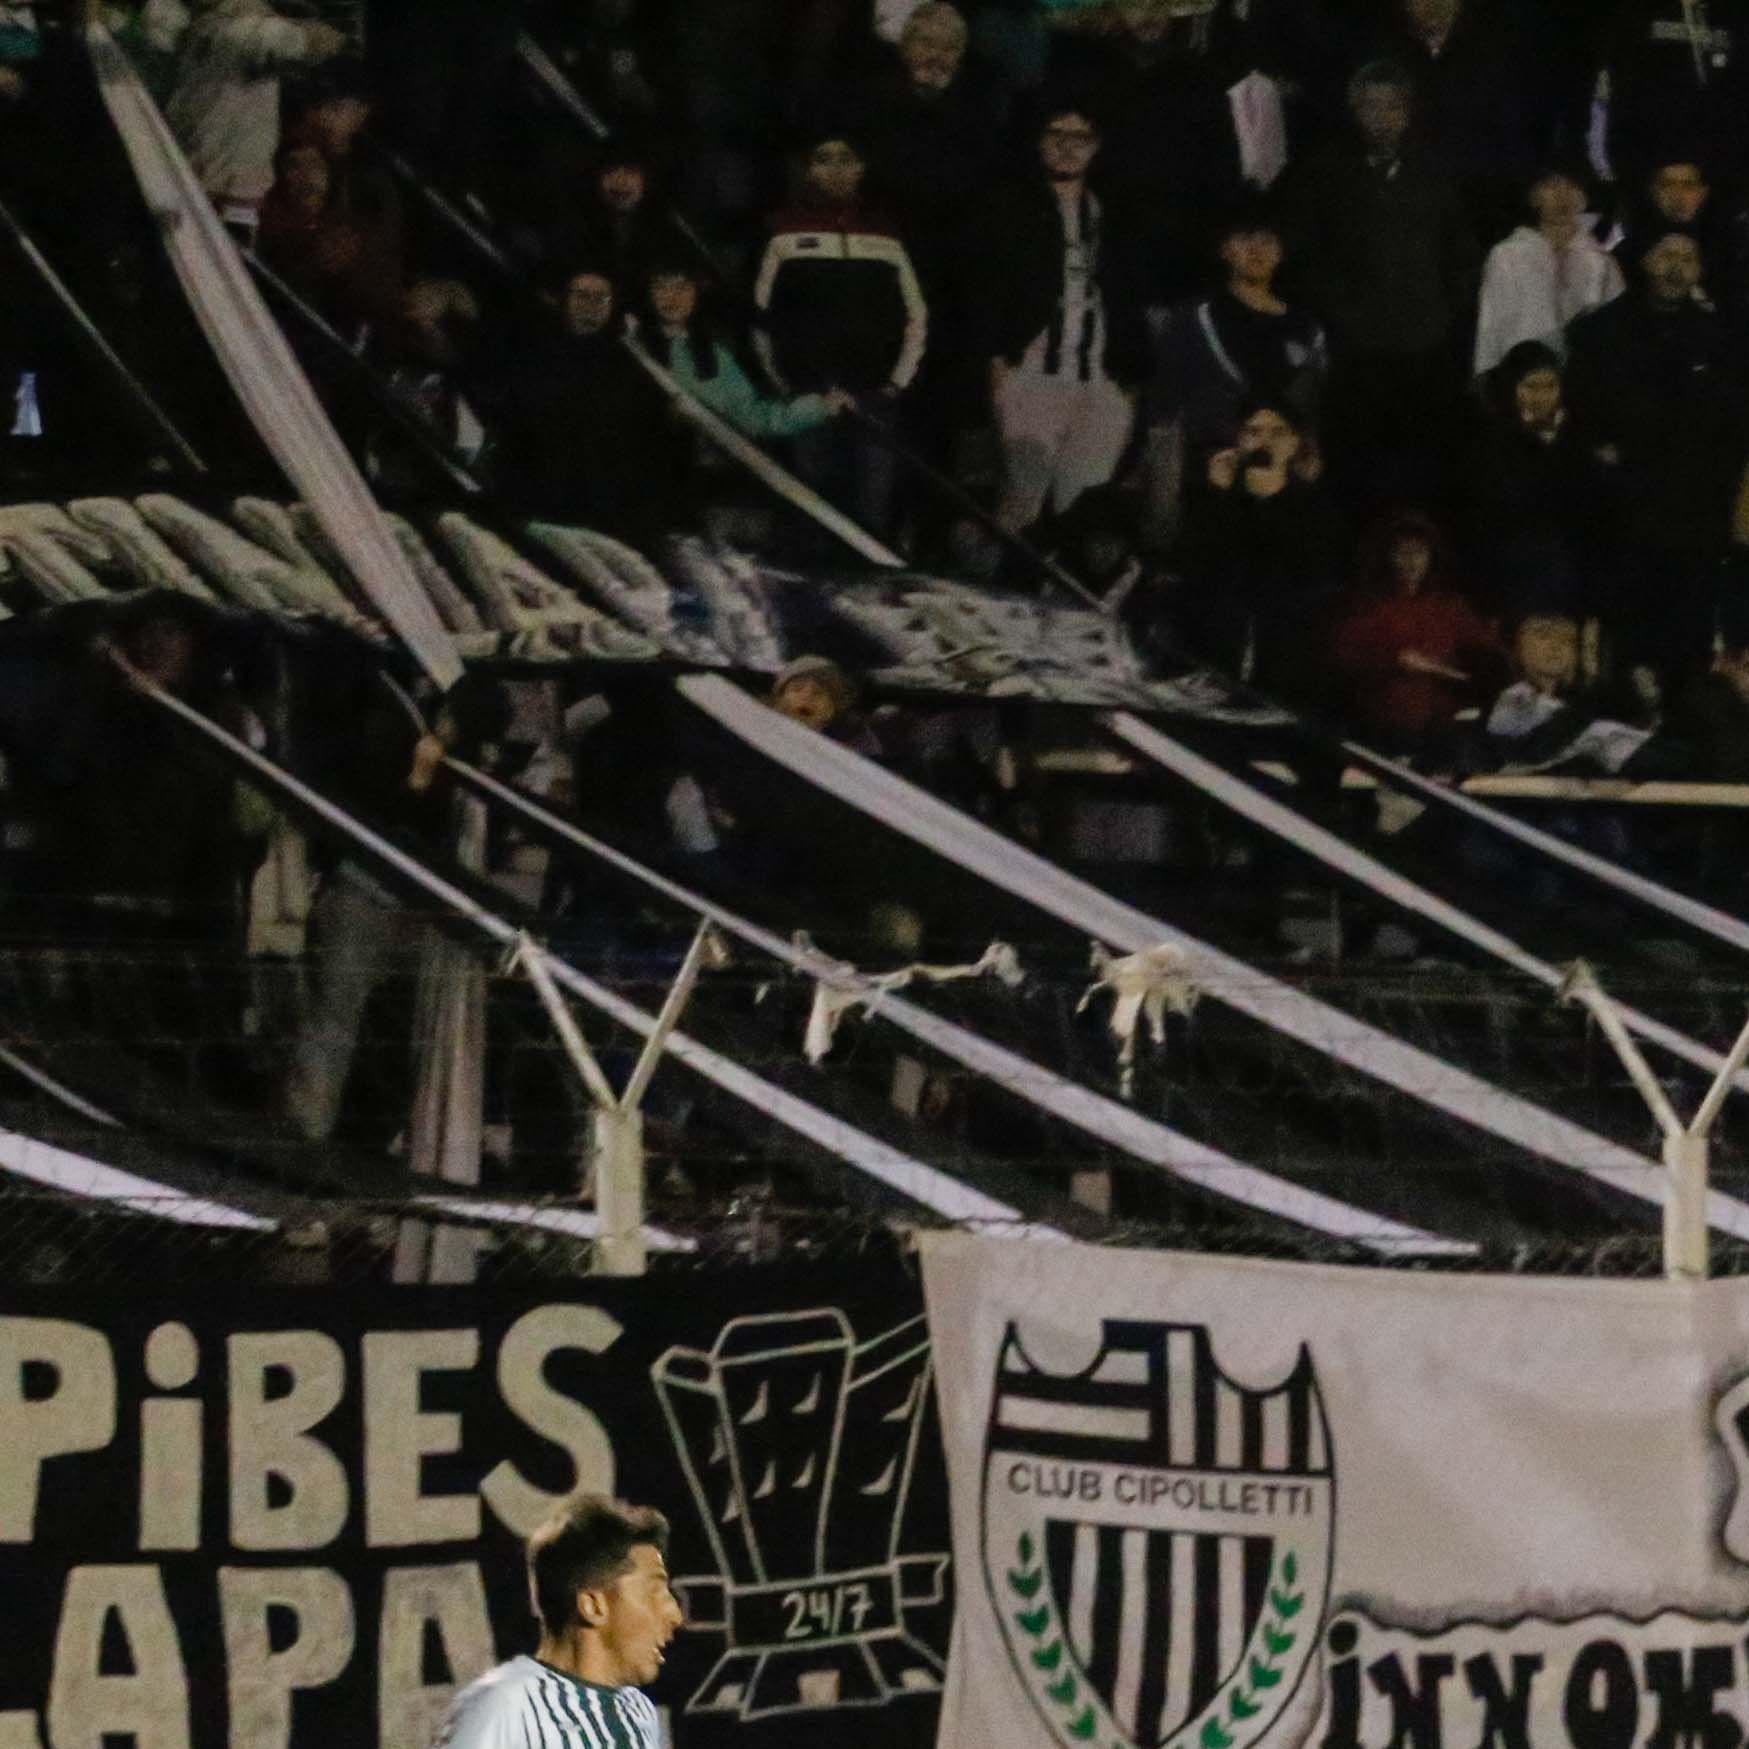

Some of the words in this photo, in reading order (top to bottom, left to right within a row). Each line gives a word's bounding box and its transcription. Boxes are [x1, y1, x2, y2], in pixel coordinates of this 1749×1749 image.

[1006, 1461, 1102, 1502] CLUB
[1113, 1468, 1314, 1516] CIPOLLETTI
[782, 1583, 874, 1639] 24/7
